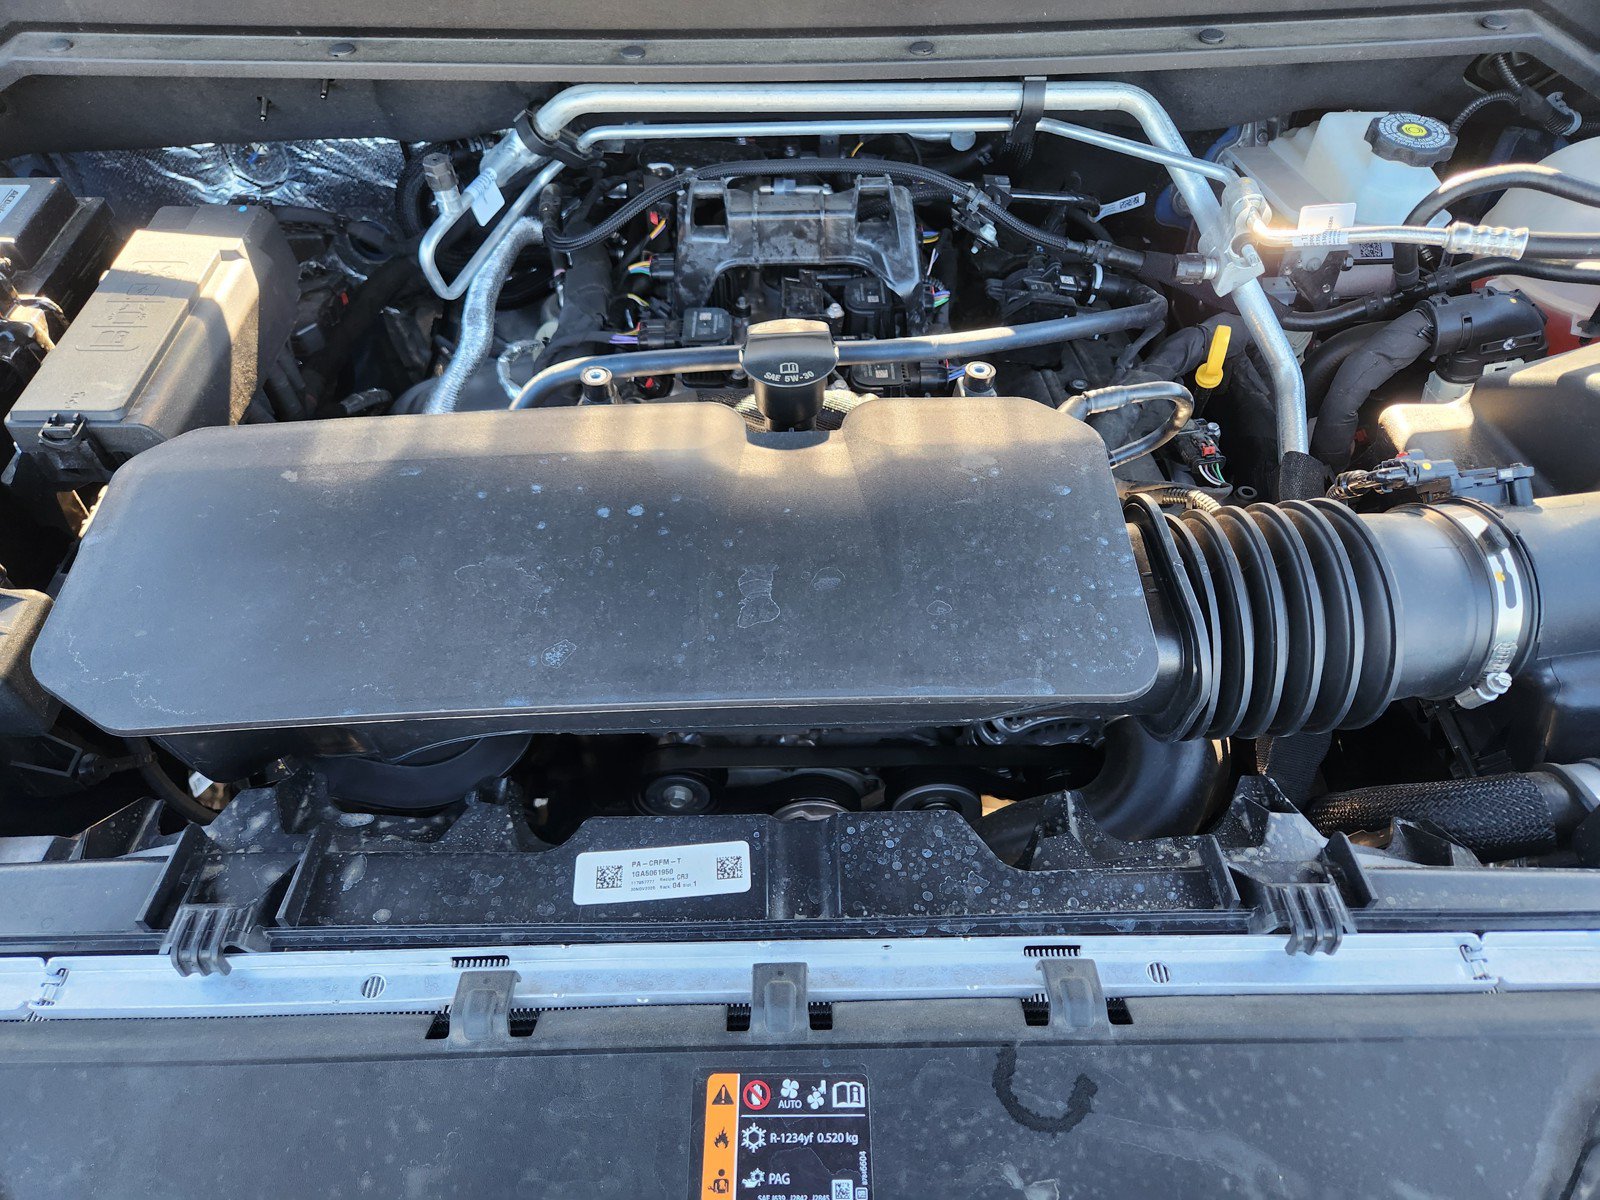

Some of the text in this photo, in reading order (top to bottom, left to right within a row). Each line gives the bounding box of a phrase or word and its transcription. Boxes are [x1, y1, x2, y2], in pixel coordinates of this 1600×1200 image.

[763, 371, 814, 382] SAE 5W-30
[778, 1099, 803, 1109] AUTO
[769, 1132, 859, 1146] R-1234yf 0.520 kg
[768, 1172, 791, 1185] PAG
